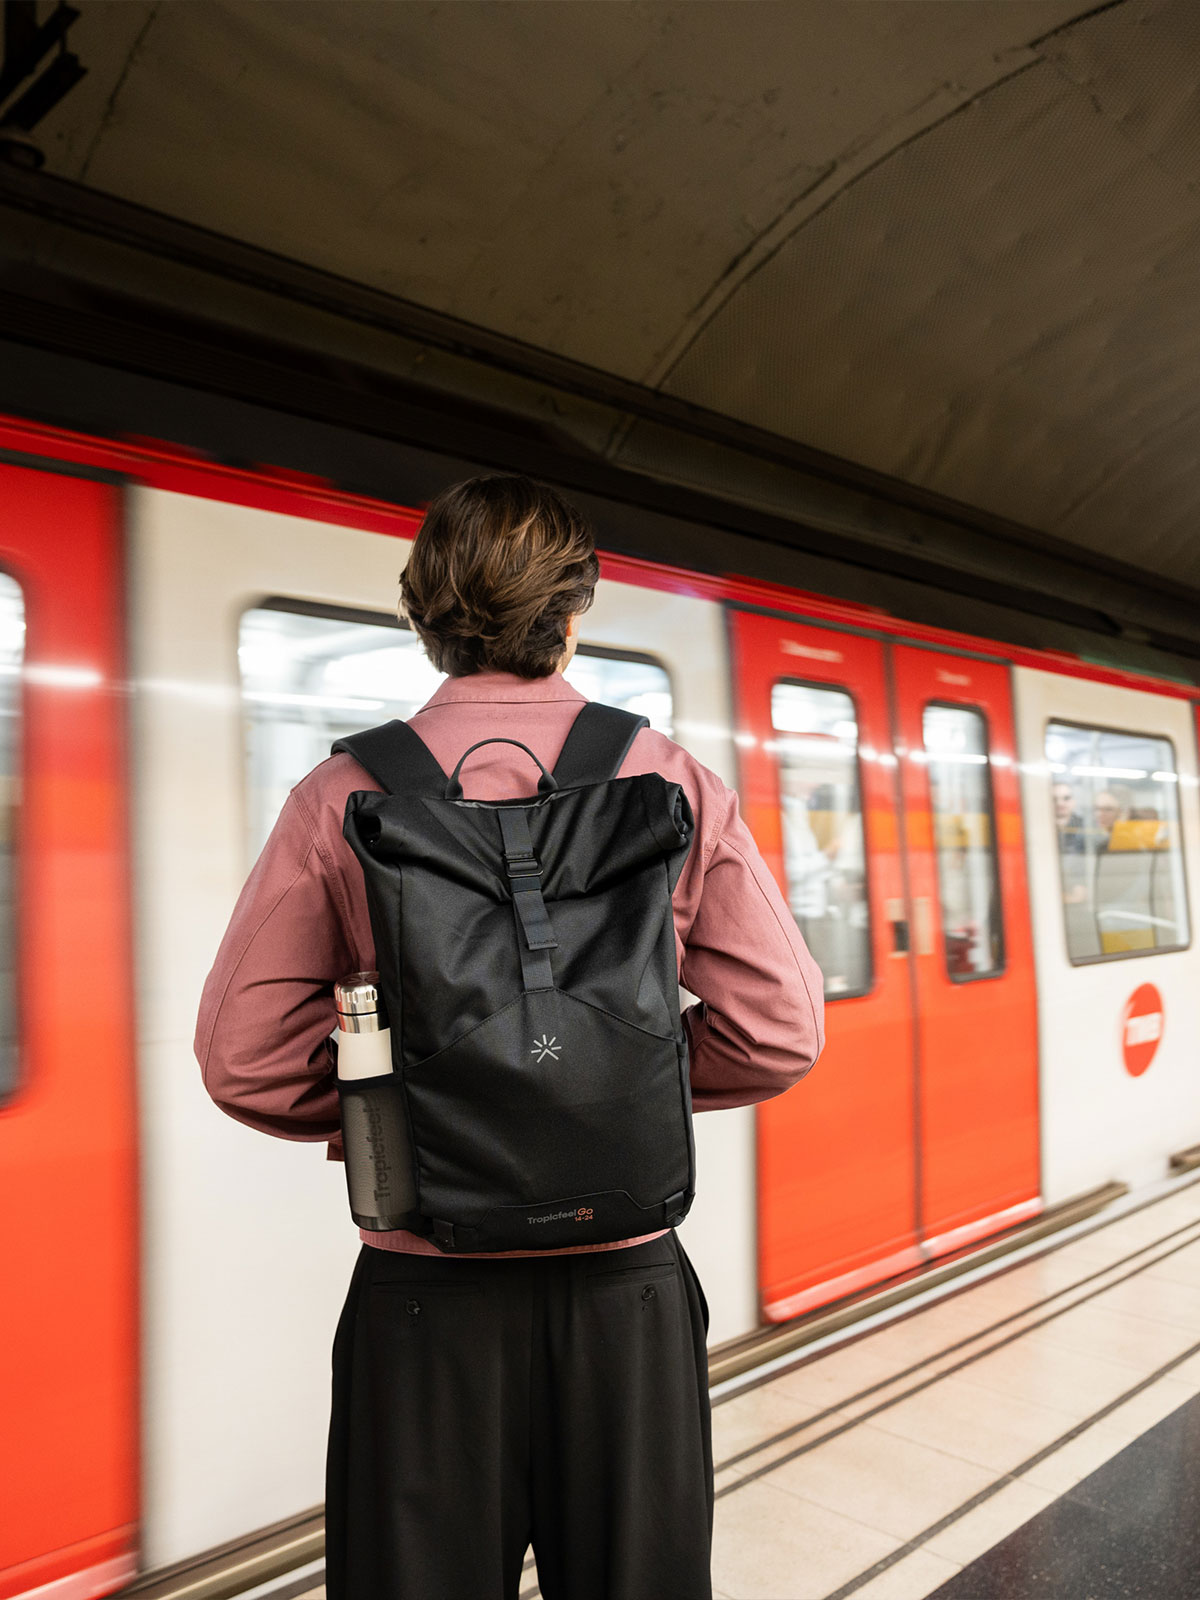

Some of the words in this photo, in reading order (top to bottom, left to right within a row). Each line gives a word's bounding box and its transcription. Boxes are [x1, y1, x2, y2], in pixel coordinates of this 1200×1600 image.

[362, 1106, 392, 1201] Tropicfeel
[527, 1209, 577, 1225] Tropicfeel
[577, 1207, 594, 1216] Go
[574, 1214, 594, 1222] 14-24
